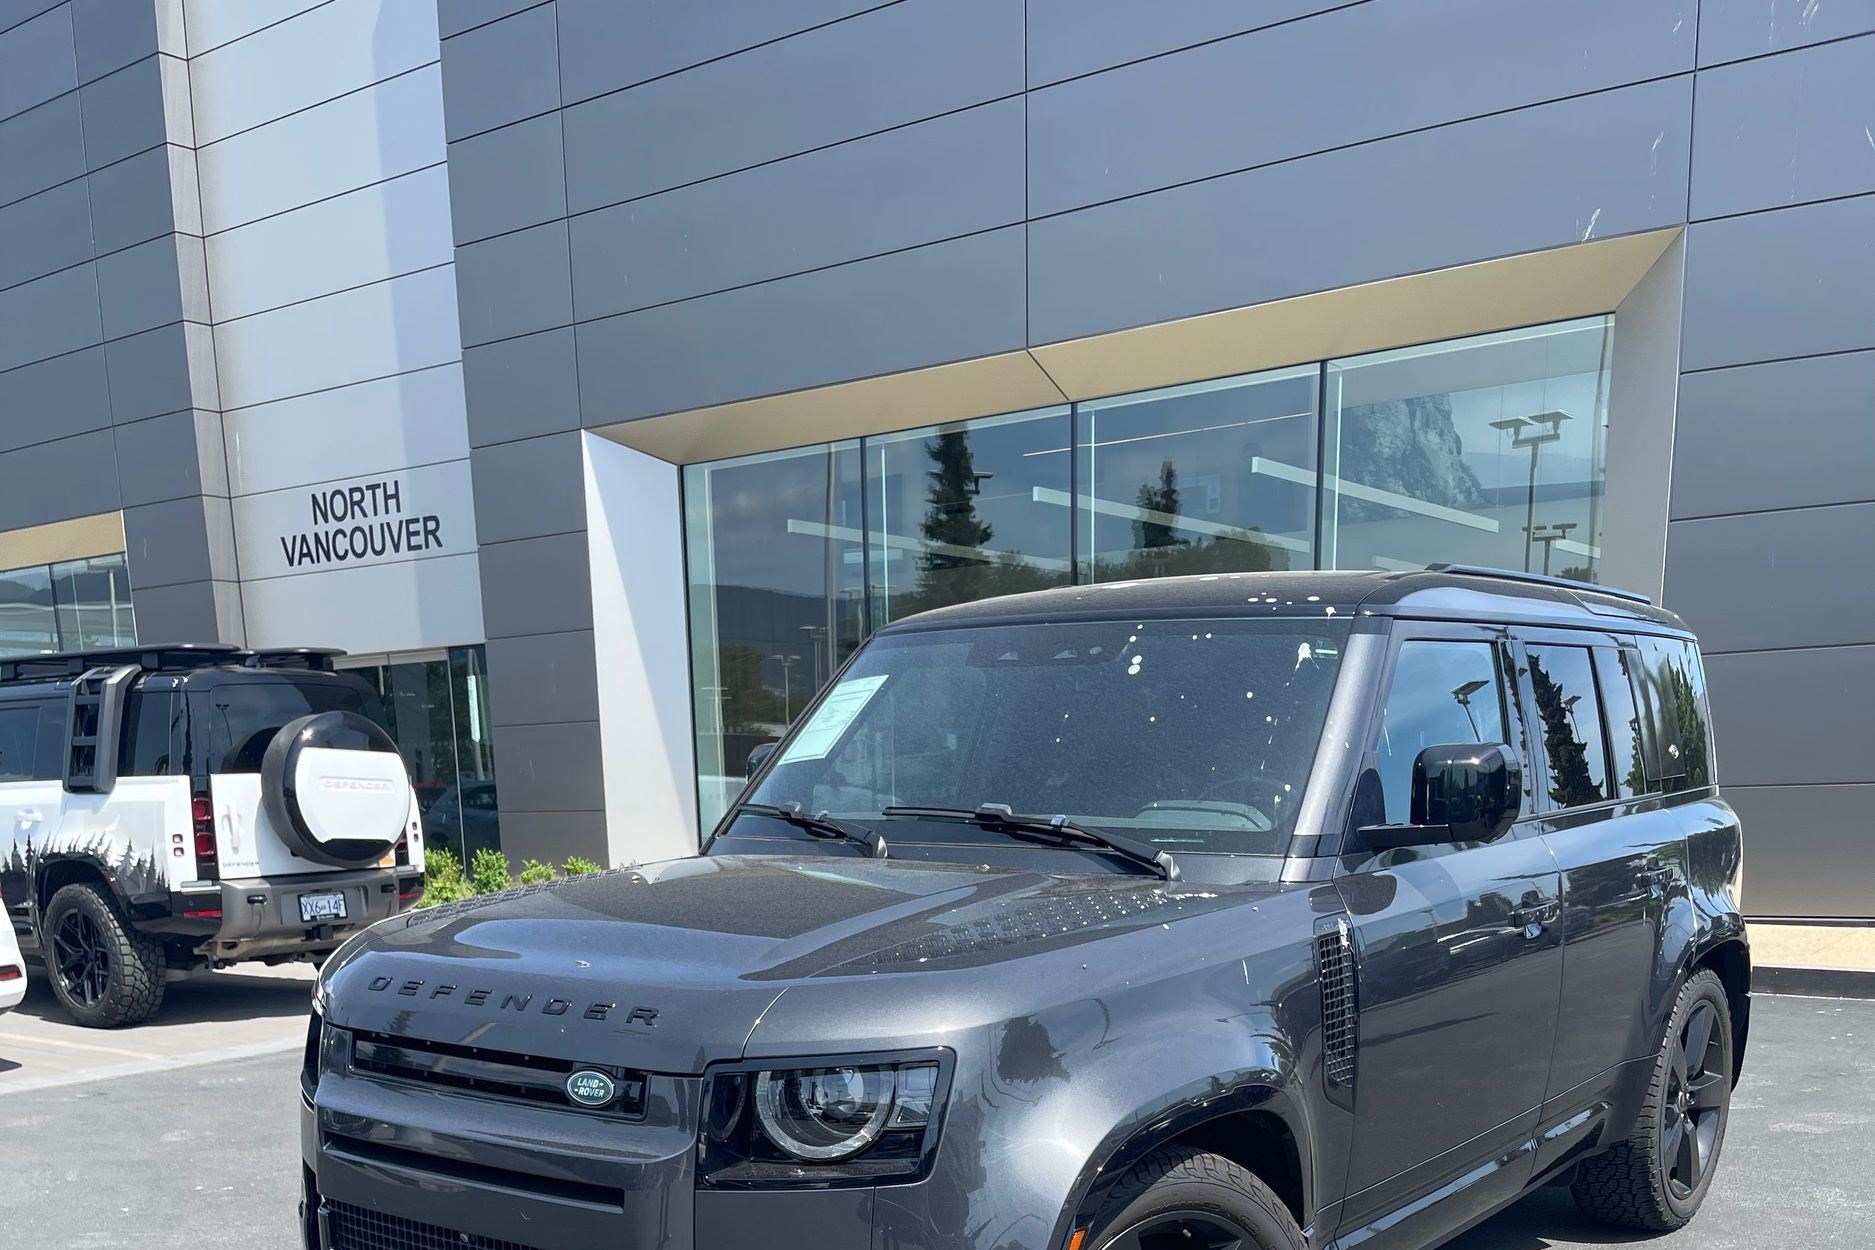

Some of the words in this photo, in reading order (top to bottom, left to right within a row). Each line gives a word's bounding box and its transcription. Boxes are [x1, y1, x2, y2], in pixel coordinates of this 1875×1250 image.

[311, 480, 401, 525] NORTH
[280, 515, 443, 567] VANCOUVER
[367, 976, 661, 1026] DEFENDER
[577, 1078, 599, 1088] LAND
[577, 1087, 605, 1098] ROVER
